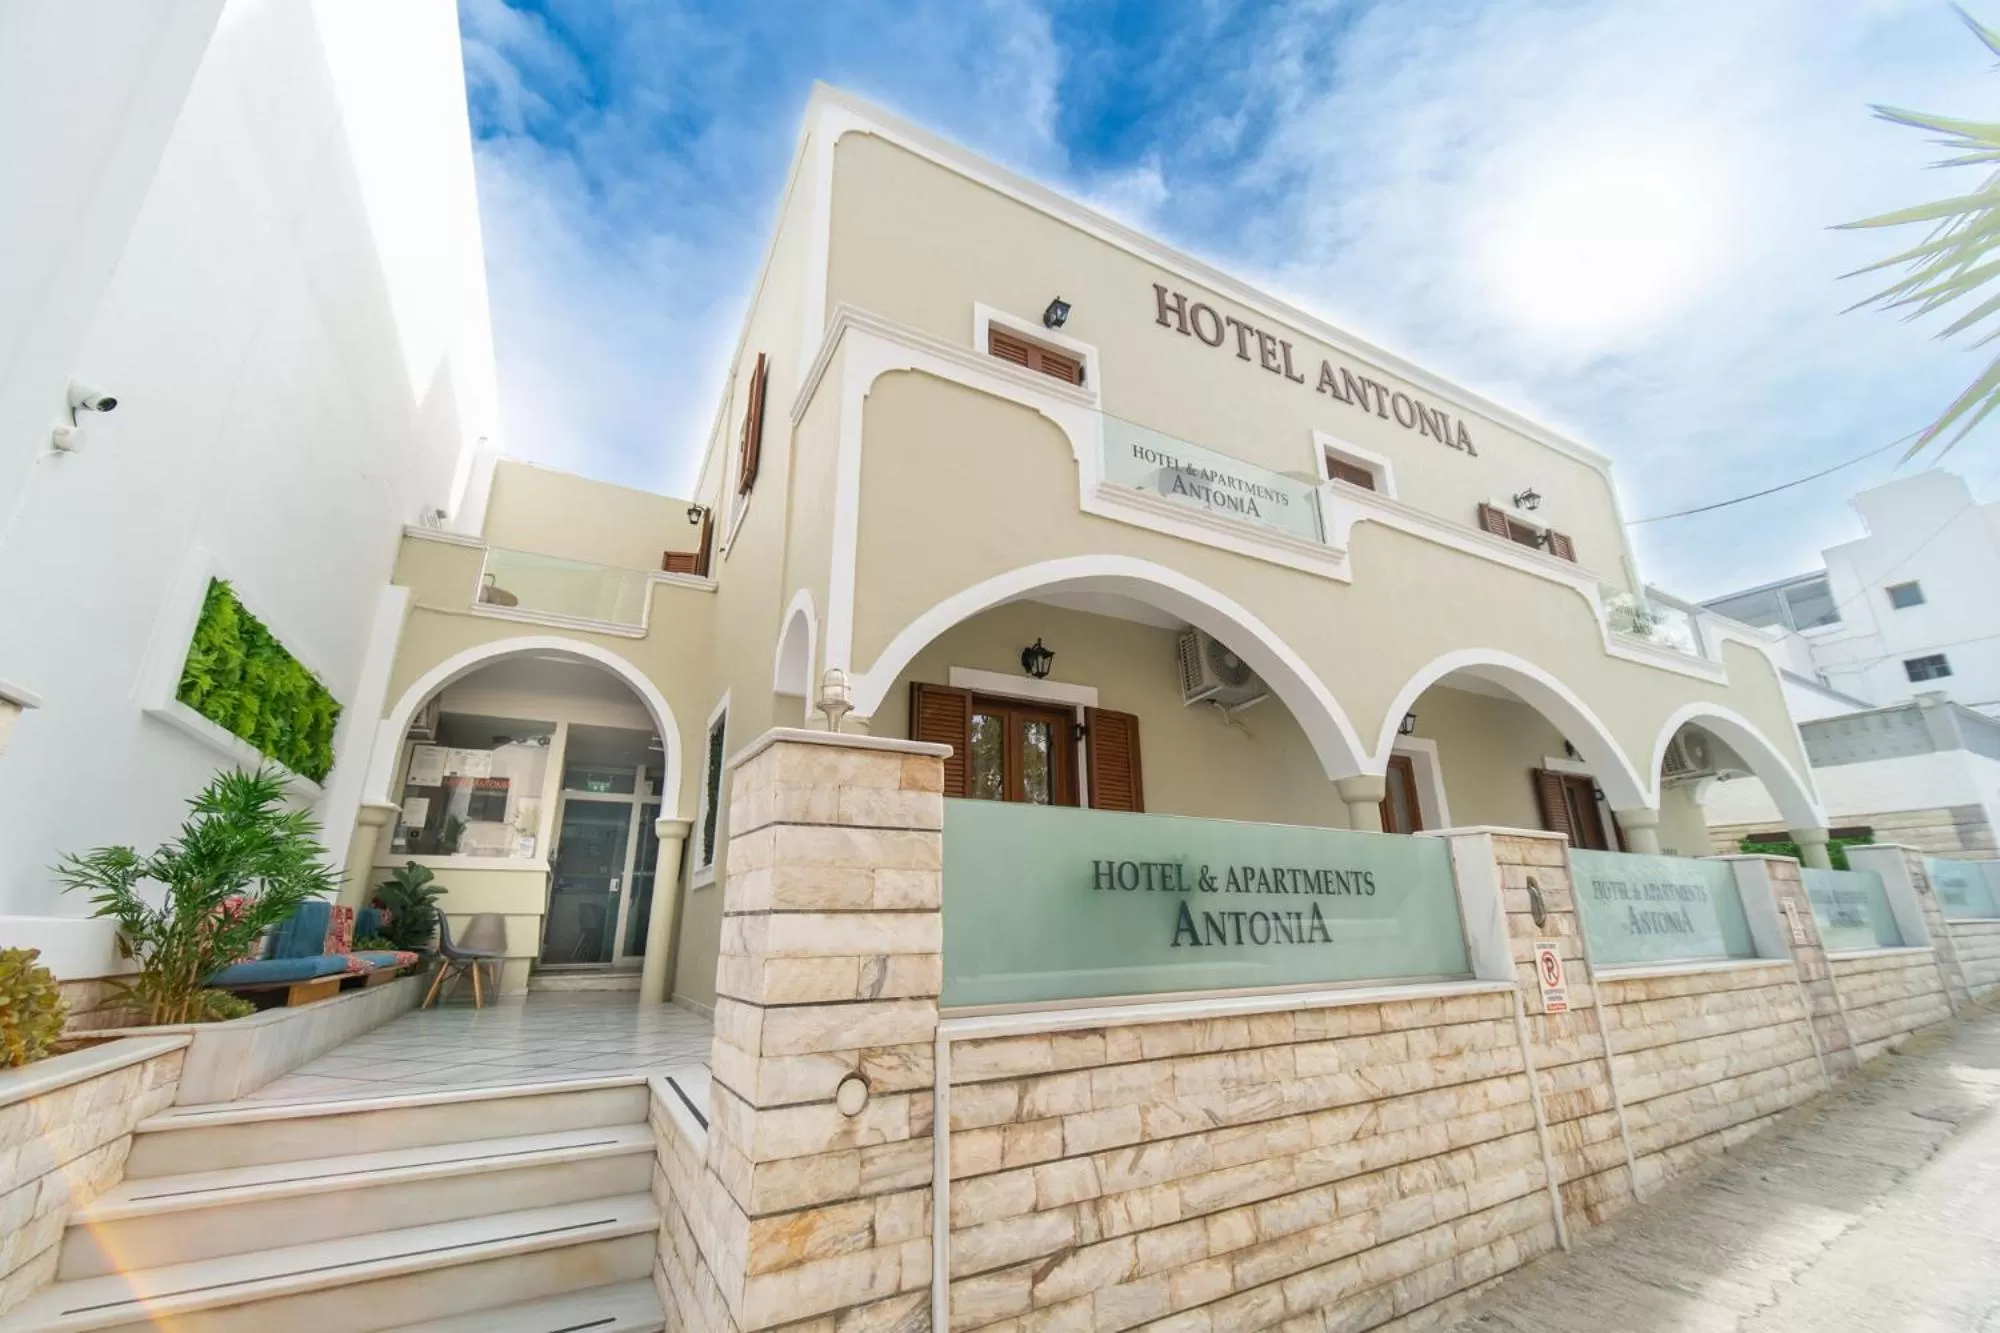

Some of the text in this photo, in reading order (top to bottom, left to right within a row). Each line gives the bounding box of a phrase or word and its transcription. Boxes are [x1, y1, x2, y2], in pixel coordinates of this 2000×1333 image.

[1153, 283, 1479, 457] HOTEL ANTONIA
[1132, 444, 1289, 507] HOTEL & APARTMENTS
[1171, 473, 1262, 518] ANTONIA
[1092, 860, 1376, 896] HOTEL & APARTMENTS
[1170, 899, 1333, 947] ANTONIA
